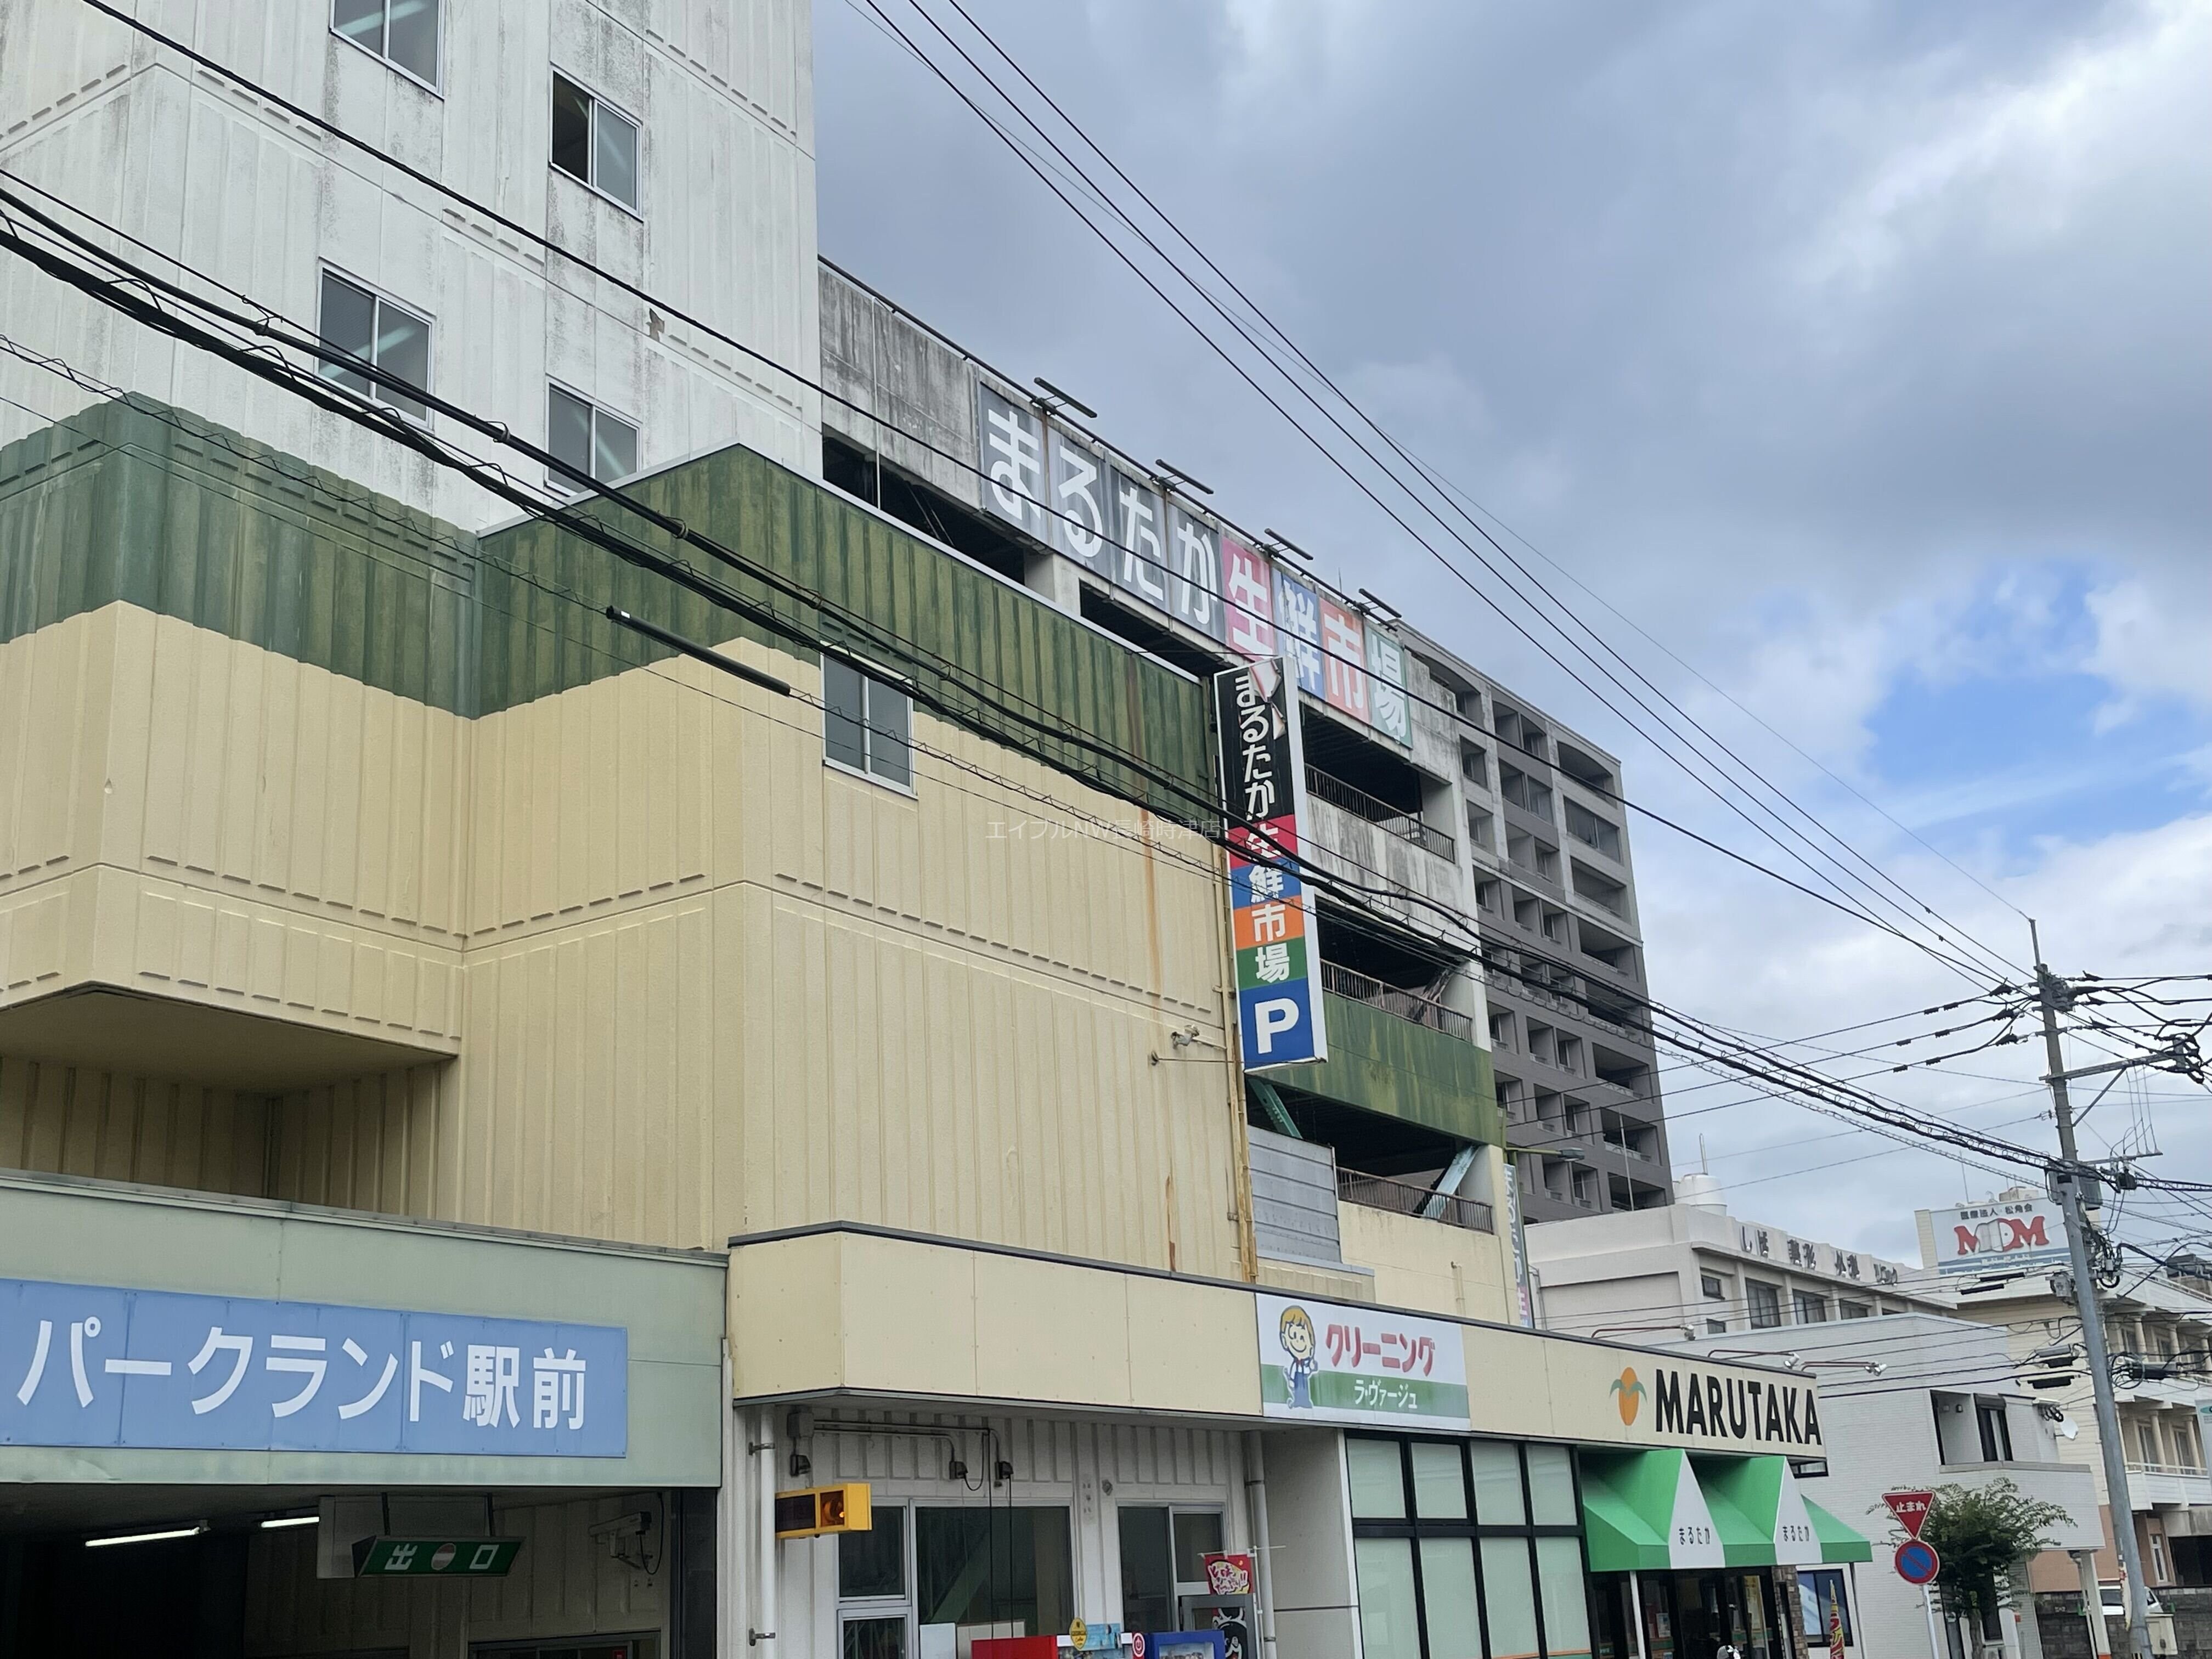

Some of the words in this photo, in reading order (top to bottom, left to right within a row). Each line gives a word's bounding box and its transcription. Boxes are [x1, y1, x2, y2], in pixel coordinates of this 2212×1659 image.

[1254, 998, 1300, 1055] P
[16, 1316, 586, 1430] パークランド駅前
[1325, 1324, 1436, 1377] クリーニング
[1656, 1369, 1822, 1446] MARUTAKA
[1895, 1501, 1927, 1513] 止まれ
[1678, 1526, 1711, 1545] まるたか
[1782, 1525, 1809, 1543] まるたか
